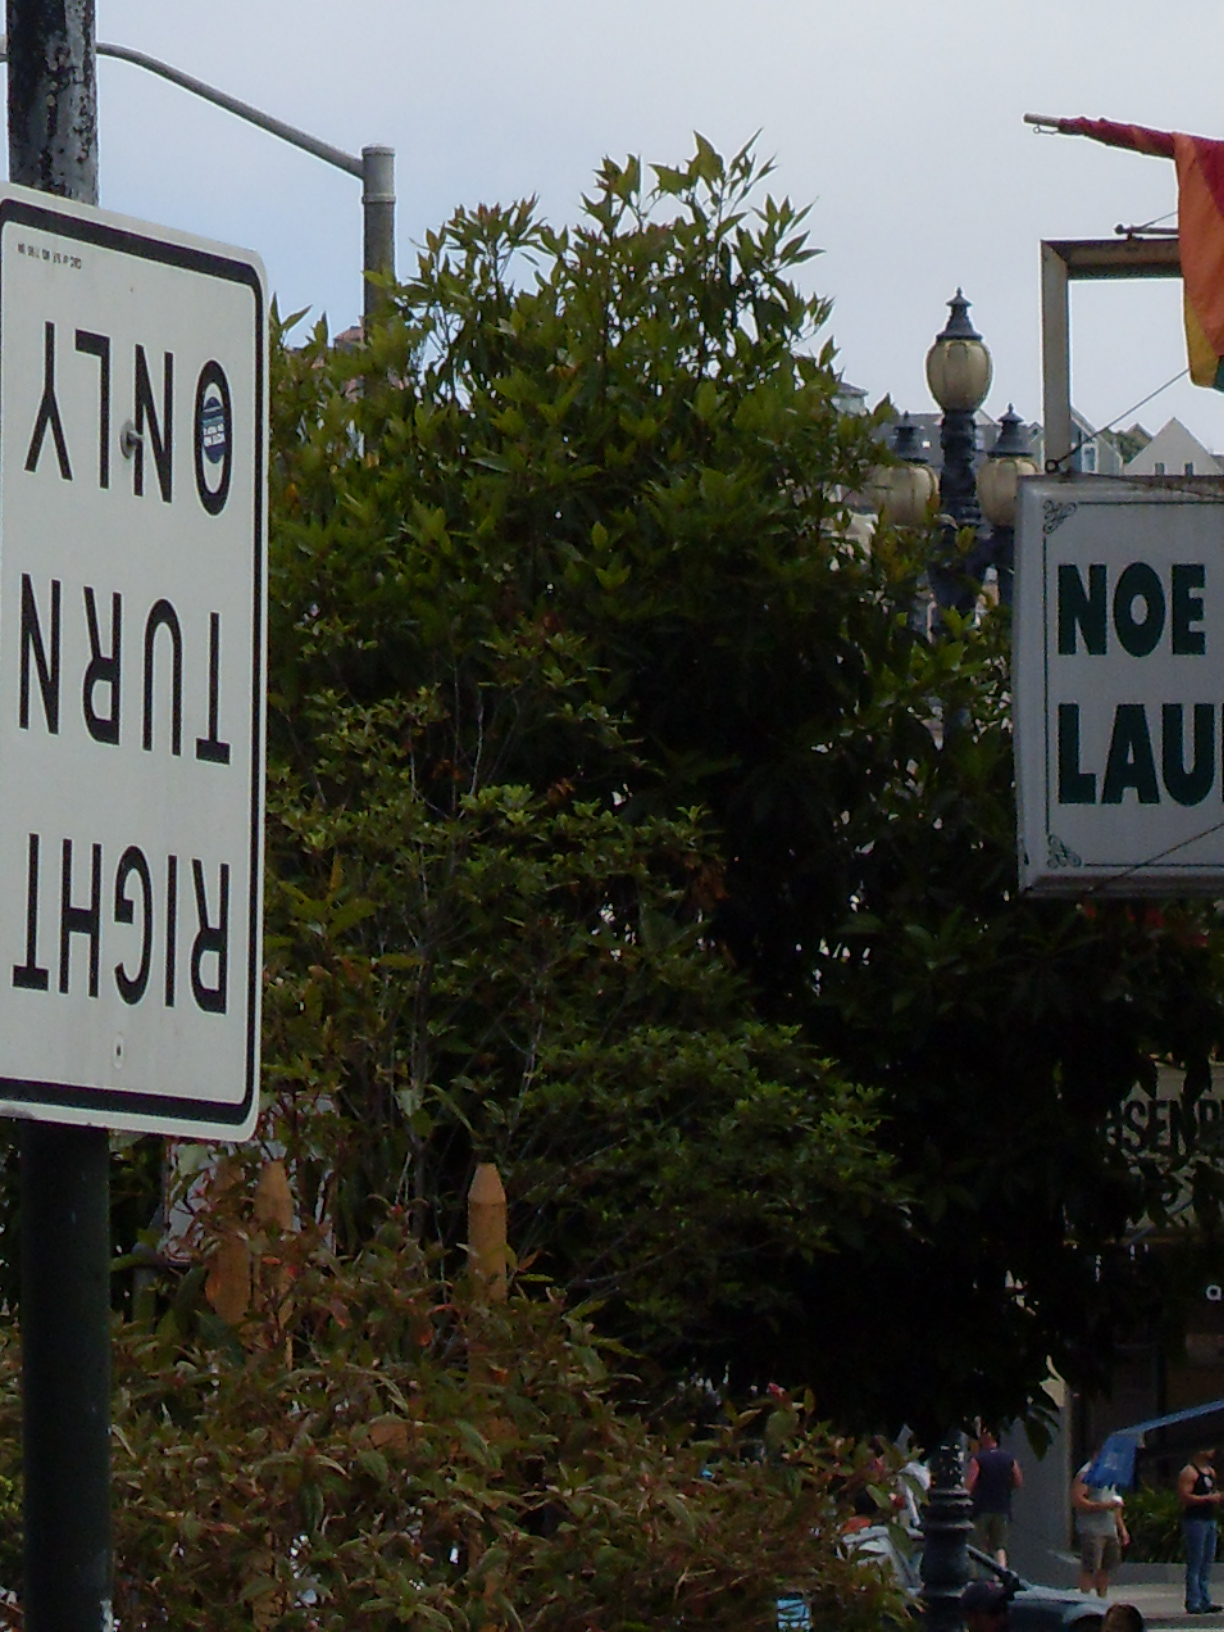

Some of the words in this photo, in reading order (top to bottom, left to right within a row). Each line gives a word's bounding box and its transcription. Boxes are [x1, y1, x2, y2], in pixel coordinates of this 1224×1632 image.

[24, 321, 233, 516] ONLY
[19, 573, 231, 766] TURN
[1057, 561, 1206, 658] NOE
[1057, 702, 1224, 808] LAU
[12, 833, 230, 1016] RIGHT
